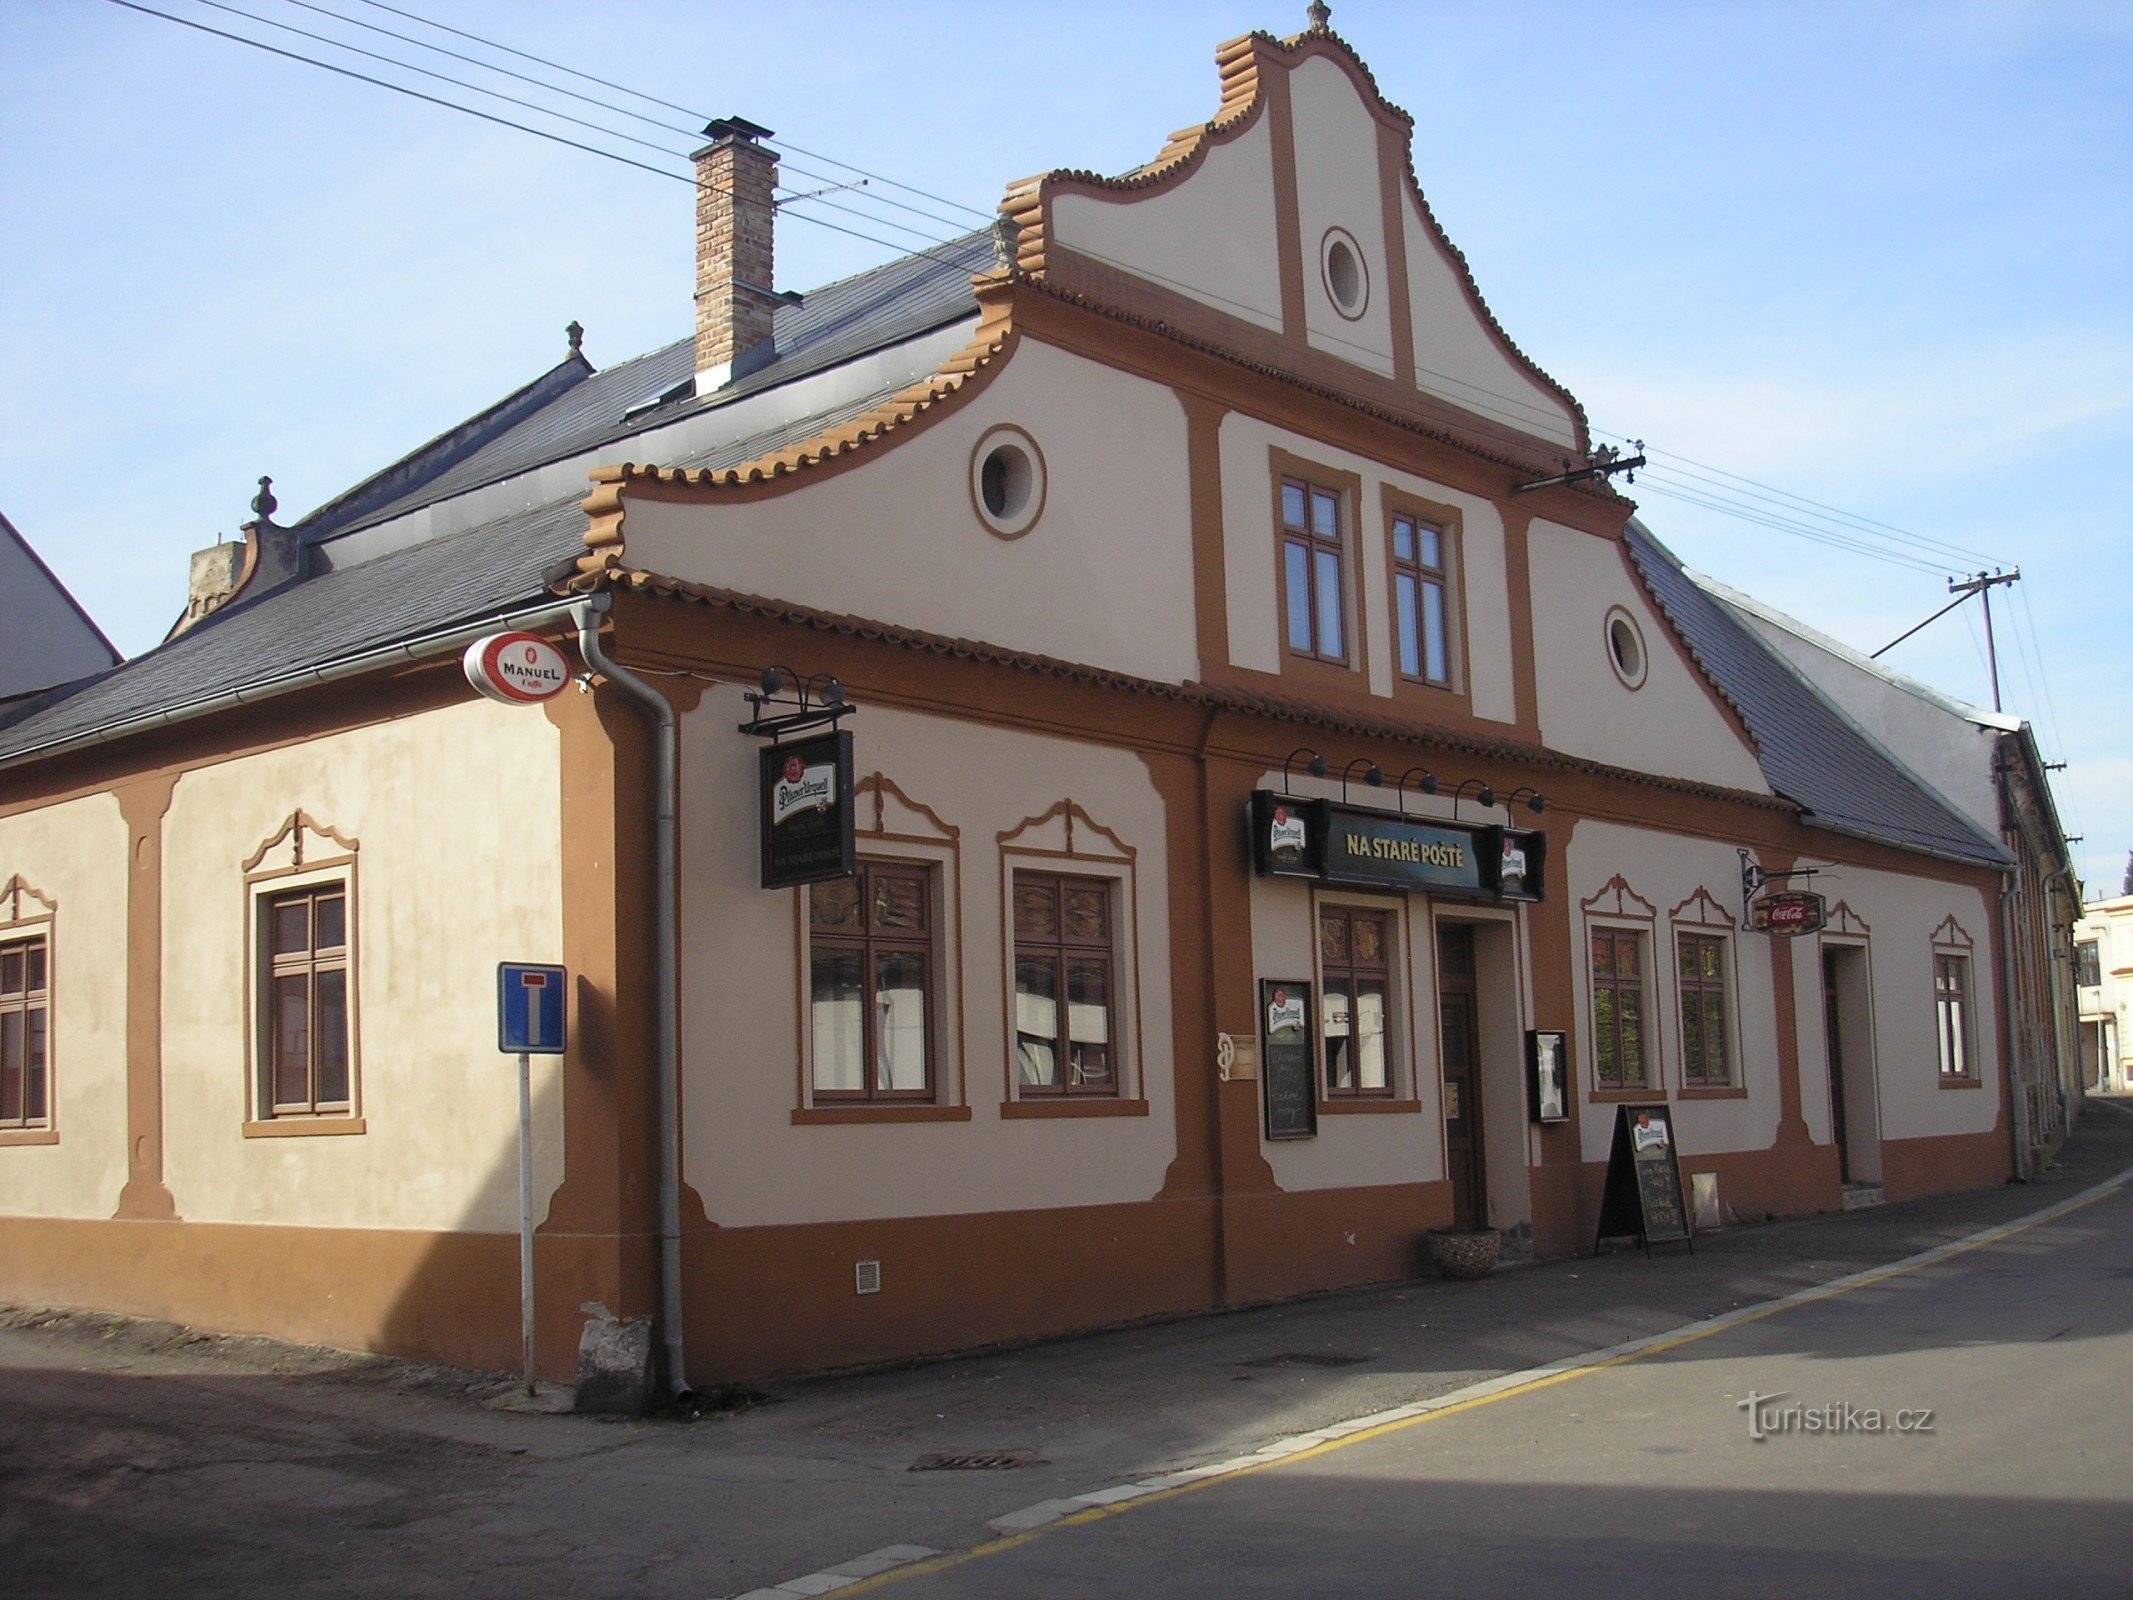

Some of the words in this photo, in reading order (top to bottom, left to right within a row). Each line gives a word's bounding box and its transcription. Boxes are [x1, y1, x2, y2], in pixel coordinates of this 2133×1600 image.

[504, 663, 560, 680] MANUEL
[1347, 834, 1370, 857] NA
[1373, 837, 1418, 861] STARÉ
[1421, 842, 1464, 868] POŠTĚ
